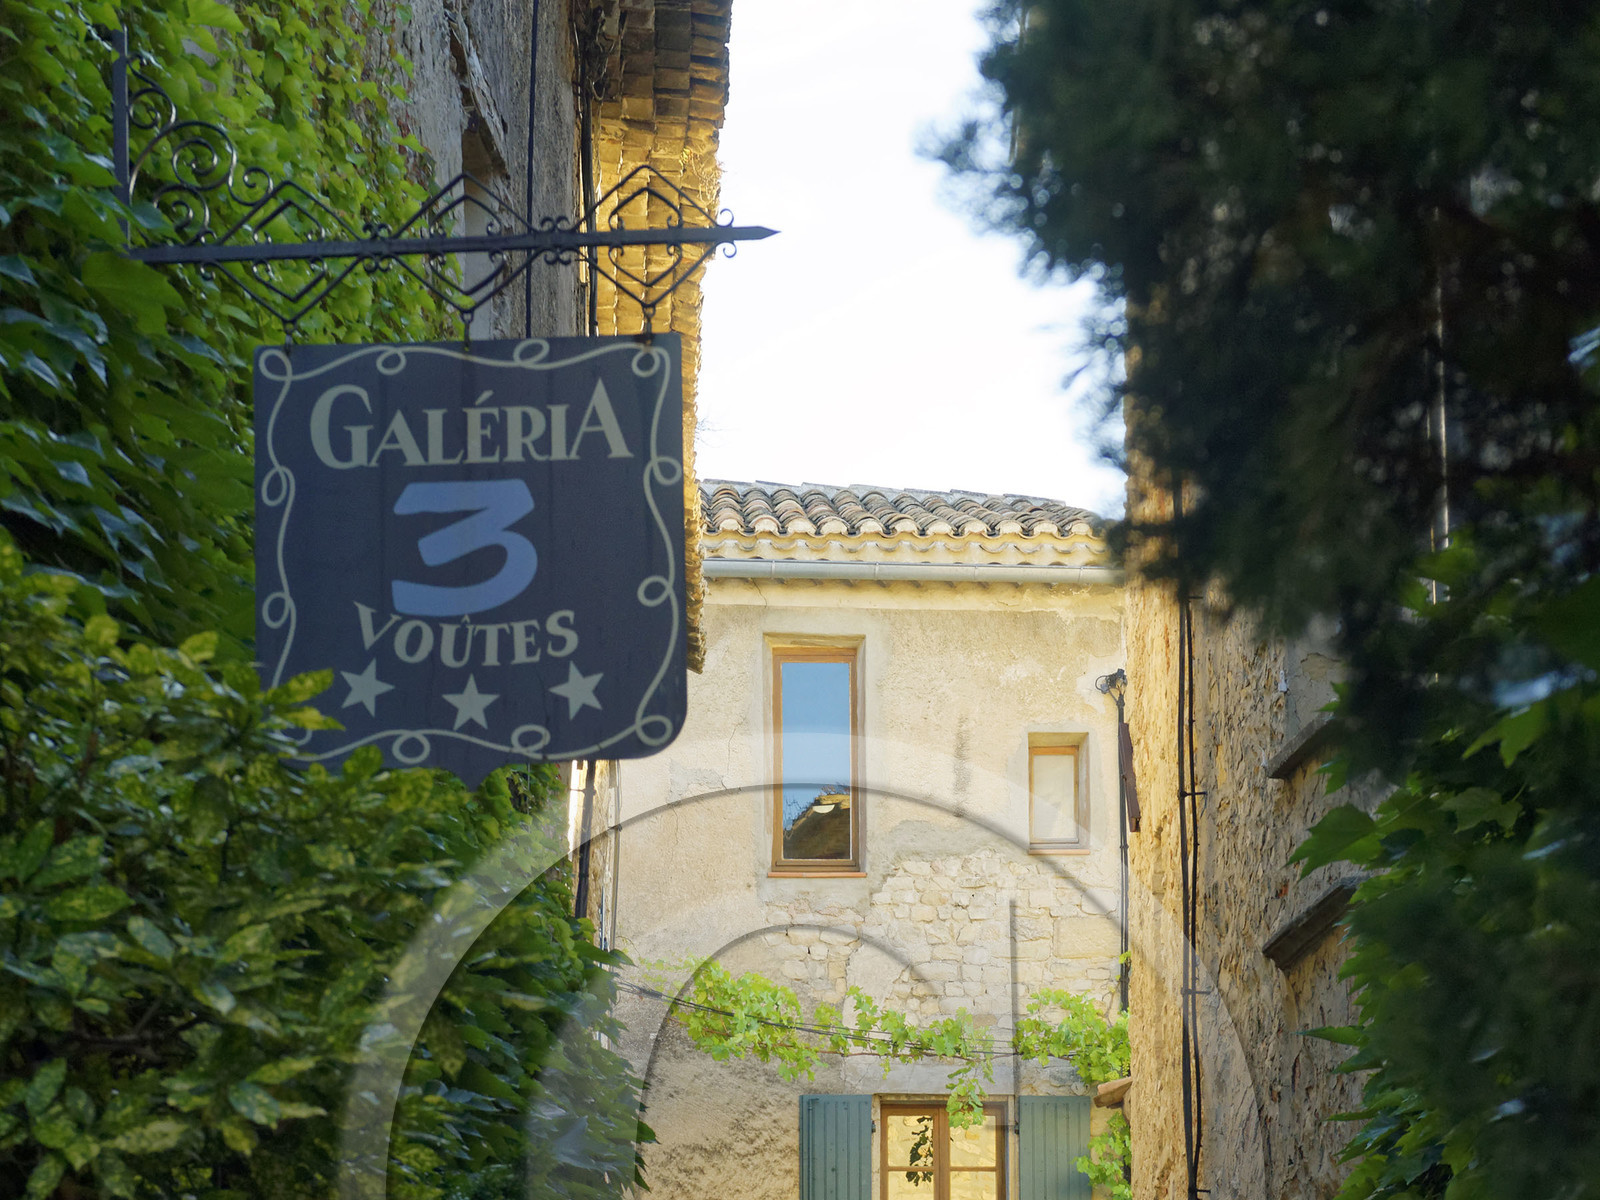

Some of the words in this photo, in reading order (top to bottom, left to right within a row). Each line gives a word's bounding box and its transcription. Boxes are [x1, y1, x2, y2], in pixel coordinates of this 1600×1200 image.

[310, 377, 635, 470] GALÉRIA
[391, 478, 538, 617] 3
[353, 601, 580, 669] VOÛTES
